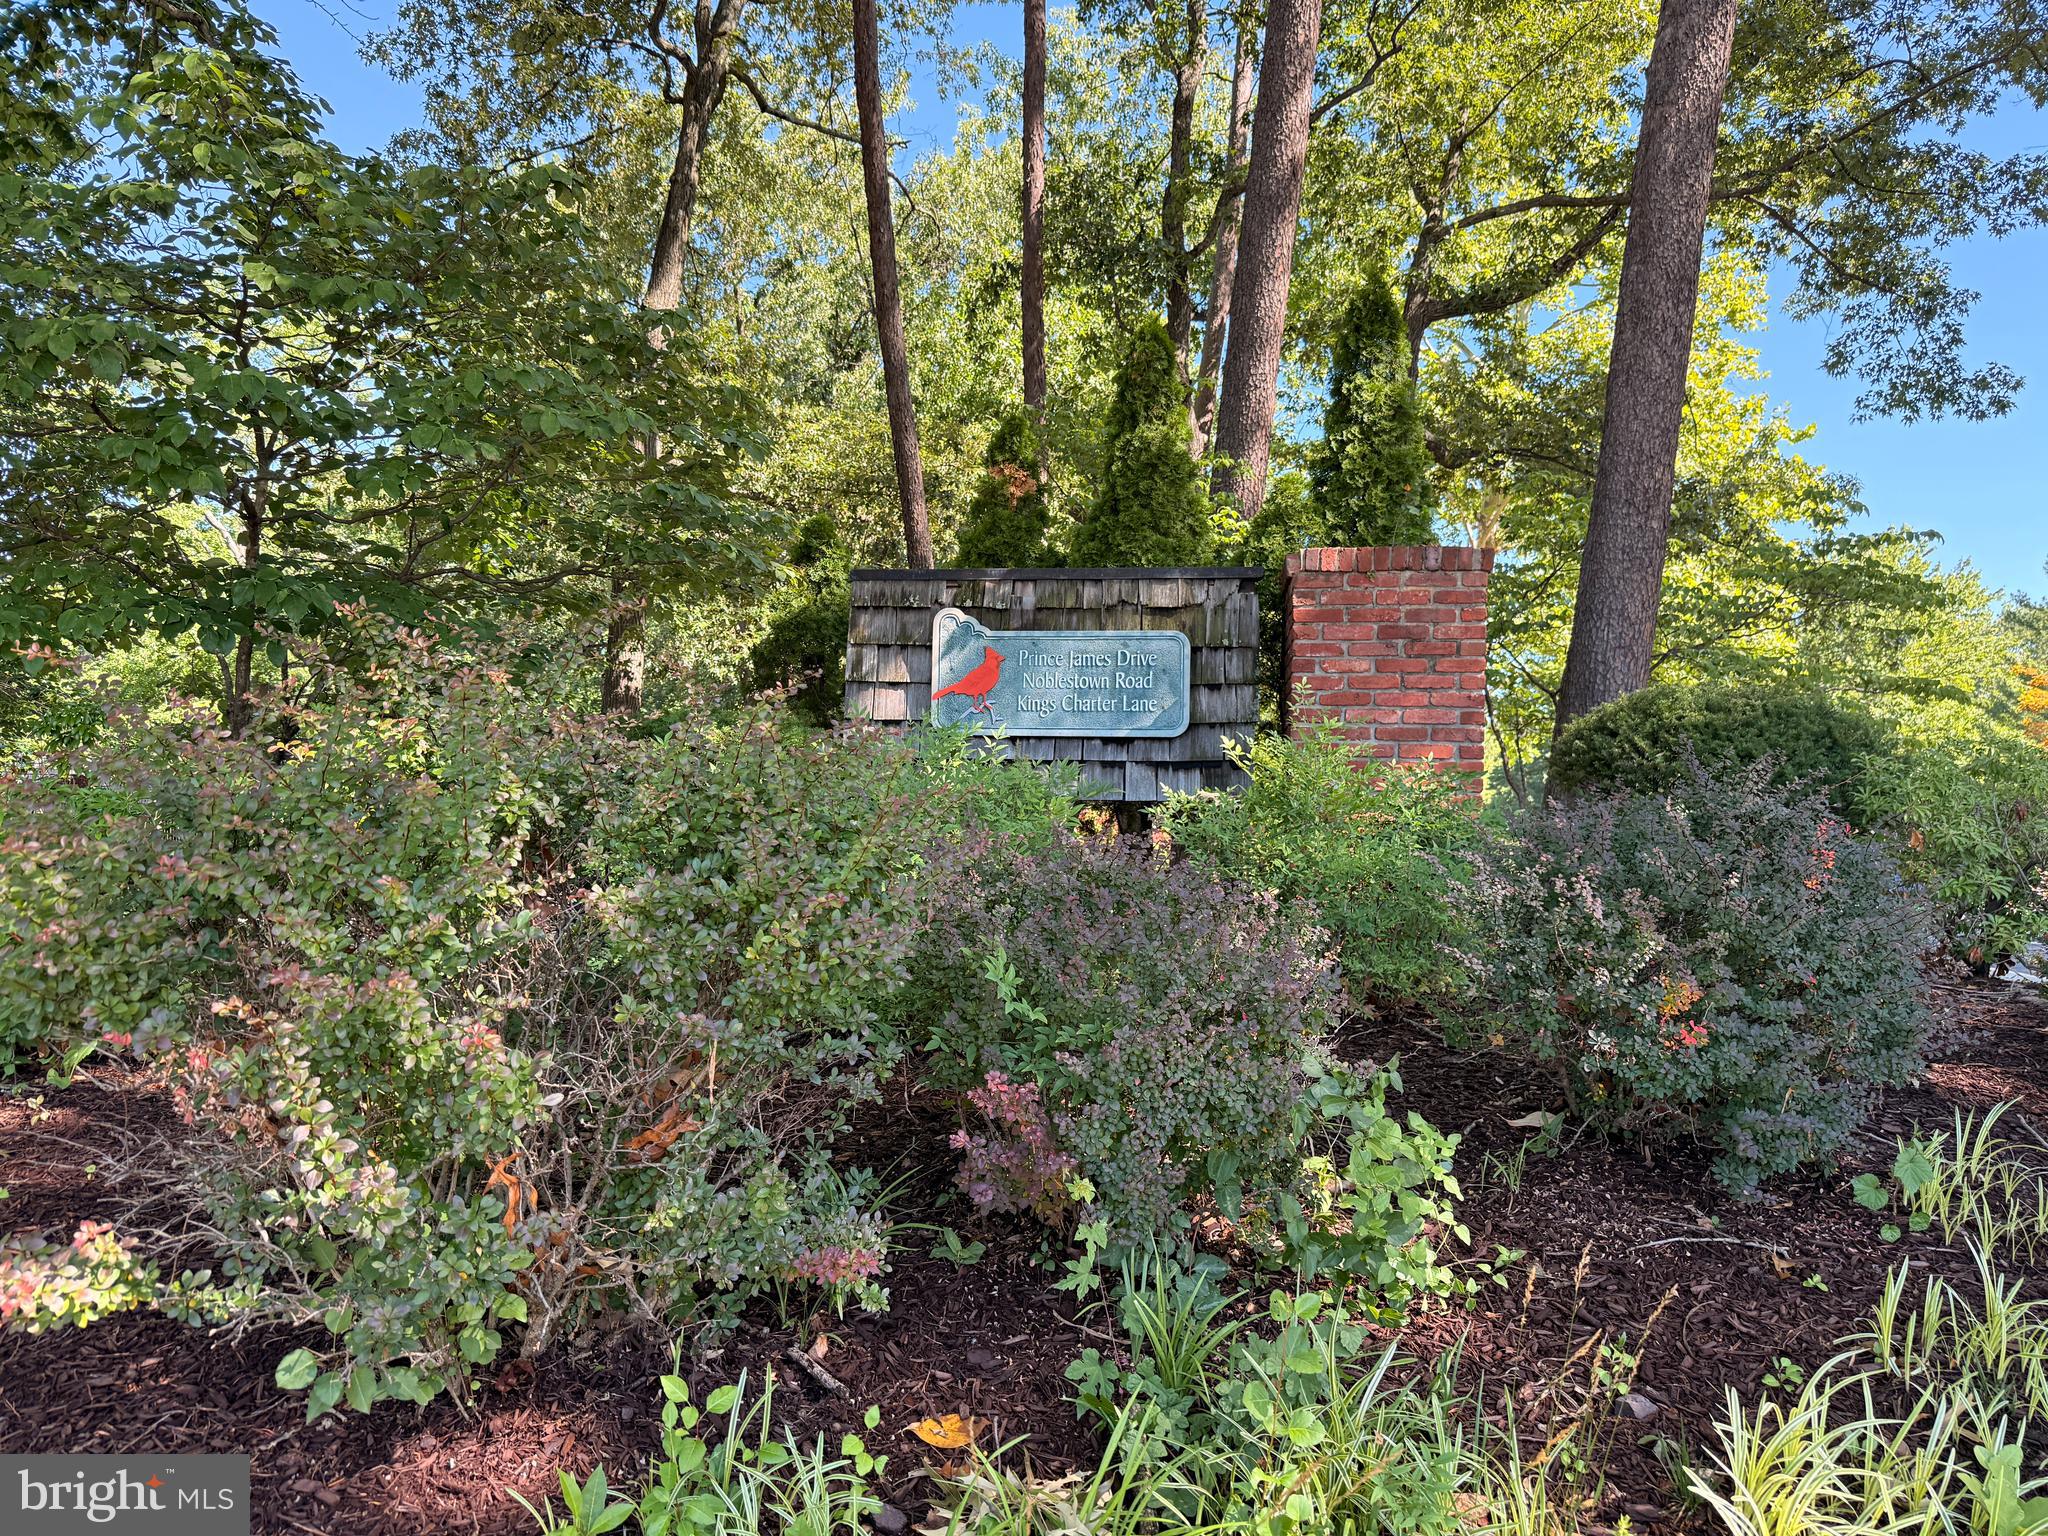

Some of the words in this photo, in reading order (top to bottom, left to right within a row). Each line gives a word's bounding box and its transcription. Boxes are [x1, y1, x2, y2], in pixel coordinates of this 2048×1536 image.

[1019, 649, 1063, 667] Prince
[1069, 650, 1111, 668] James
[1117, 649, 1157, 666] Drive
[1023, 672, 1109, 689] Noblestown
[1115, 671, 1153, 689] Road
[1017, 696, 1056, 717] Kings
[1062, 695, 1118, 712] Charter
[1123, 696, 1158, 712] Lane
